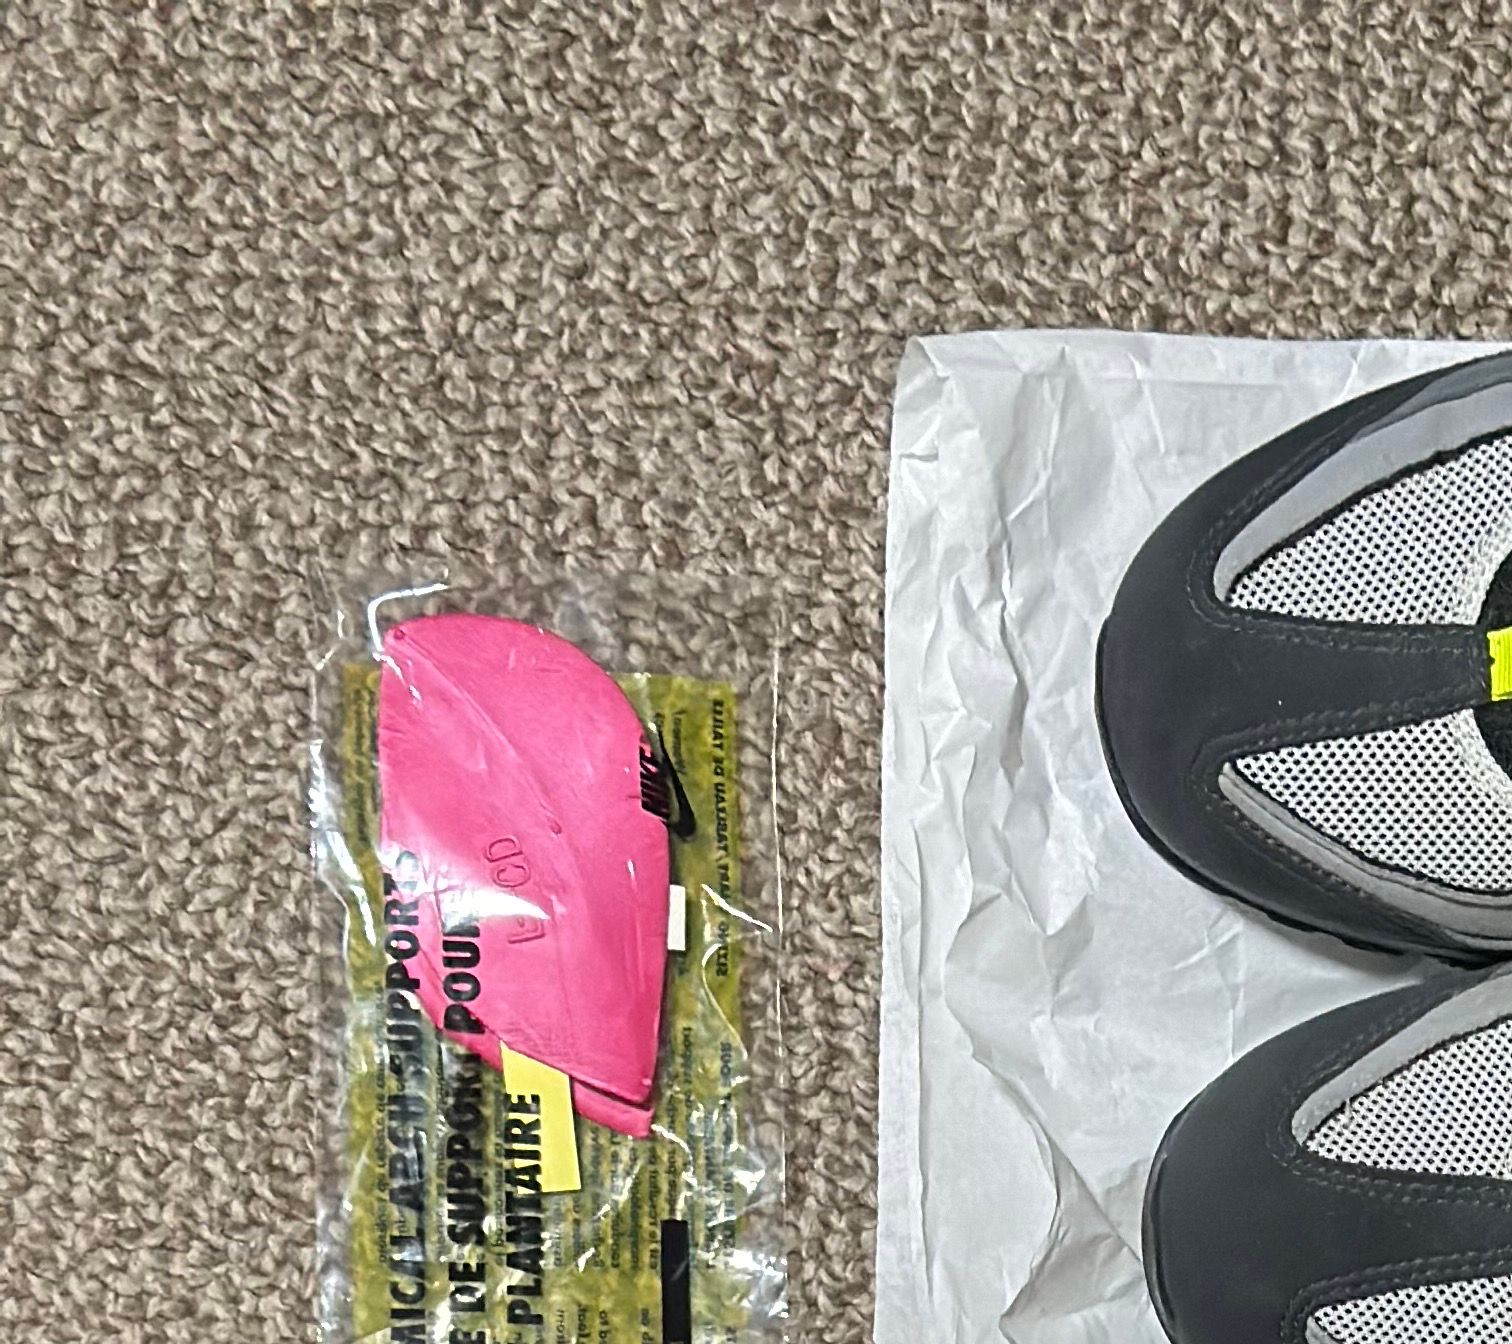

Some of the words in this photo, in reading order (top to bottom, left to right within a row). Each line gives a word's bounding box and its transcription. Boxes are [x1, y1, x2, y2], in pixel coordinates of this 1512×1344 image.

[638, 744, 670, 818] NIKE
[383, 849, 422, 1076] SUPPORTS
[387, 1093, 426, 1211] ARCH
[444, 1051, 486, 1245] SUPPORT
[503, 1092, 545, 1324] PLANTAIRE
[448, 1261, 486, 1312] DE
